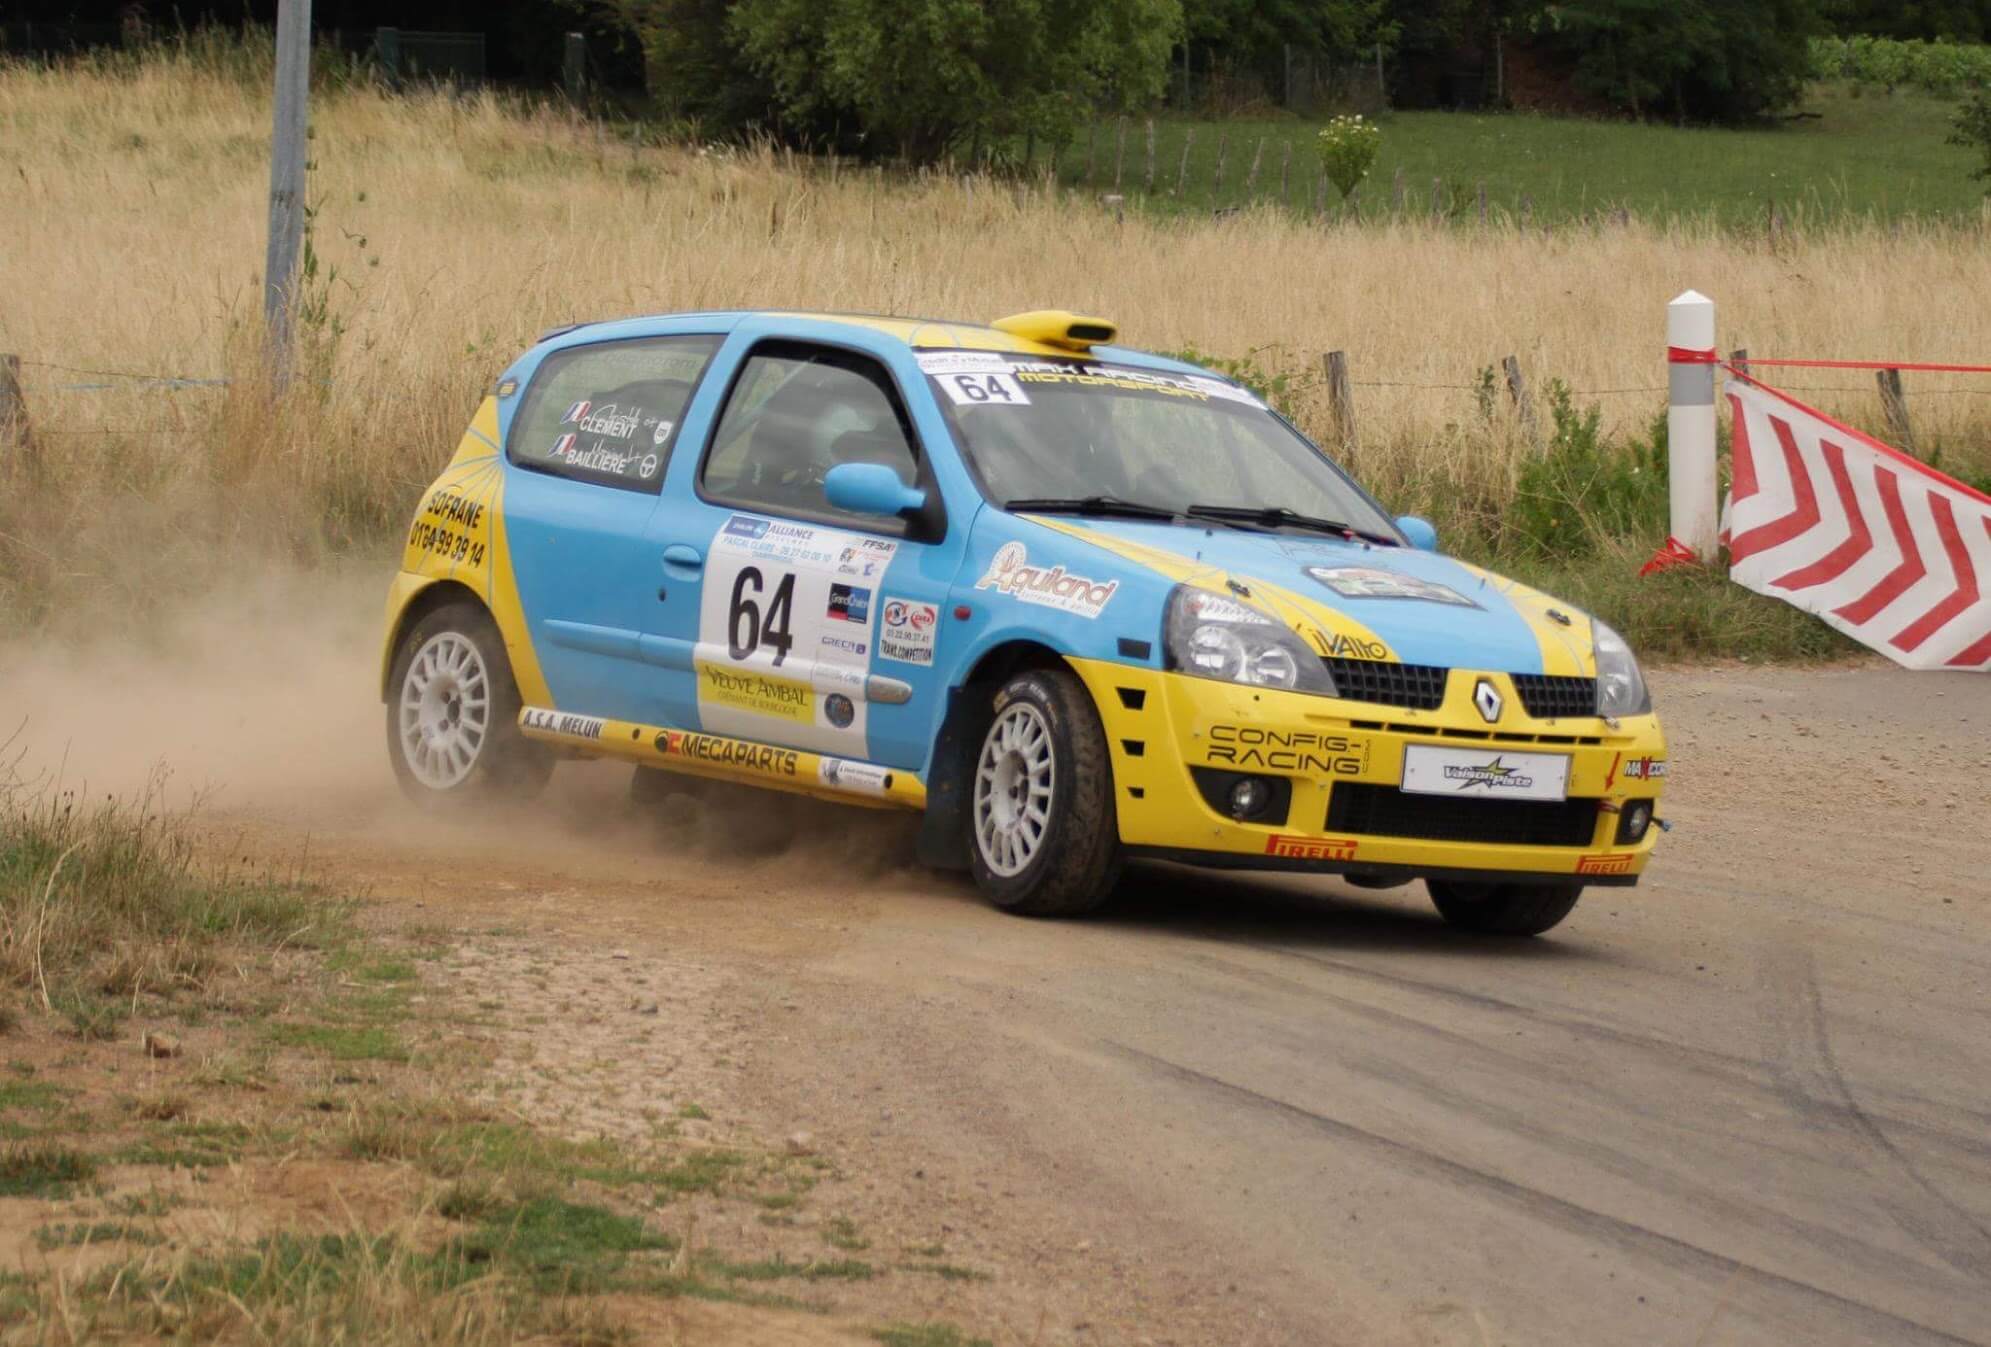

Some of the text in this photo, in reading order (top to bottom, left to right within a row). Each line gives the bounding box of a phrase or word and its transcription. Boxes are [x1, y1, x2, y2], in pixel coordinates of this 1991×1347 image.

[954, 375, 1012, 401] 64
[1017, 372, 1210, 401] MOTORSPORT
[580, 415, 638, 439] CLEMENT
[565, 449, 627, 474] BAILLIERE
[428, 491, 485, 529] SOFRANE
[769, 525, 815, 540] ALLIANCE
[862, 539, 891, 551] FFSA
[467, 541, 485, 568] 14
[728, 566, 796, 667] 64
[705, 665, 808, 706] VEUVE AMBAL
[560, 716, 602, 739] MELUN
[681, 733, 798, 776] MECAPARTS
[1207, 745, 1361, 775] RACING
[1265, 834, 1358, 861] PIRELLI
[1577, 853, 1633, 873] PIRELLI
